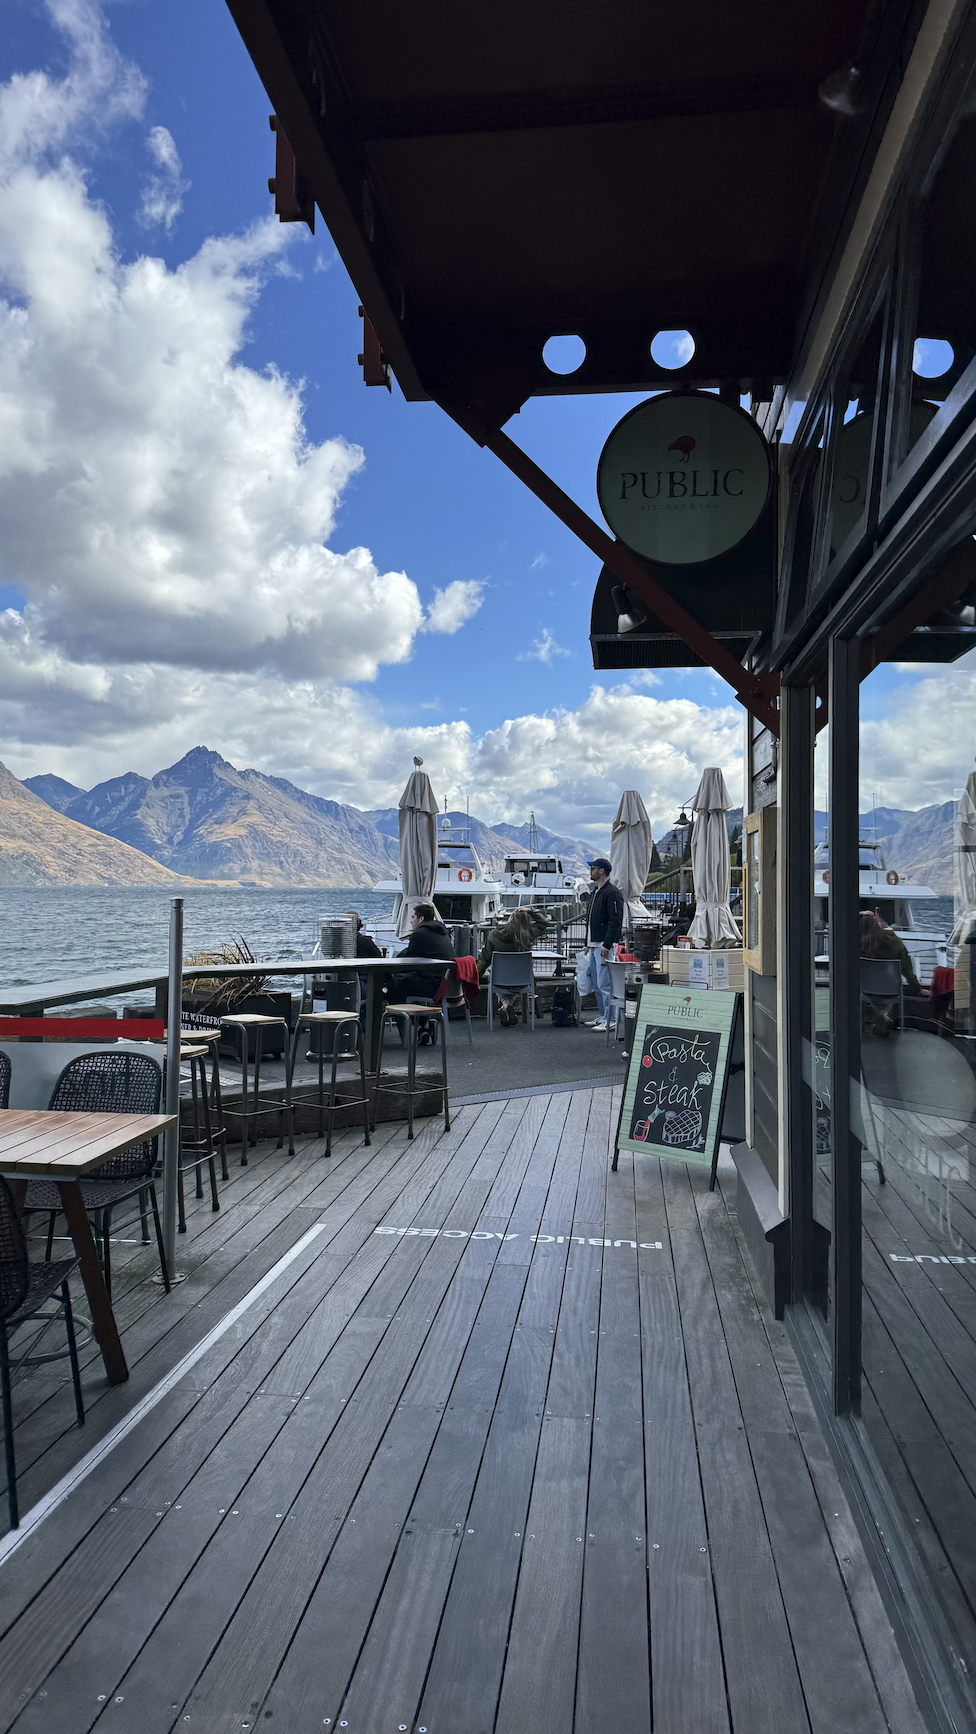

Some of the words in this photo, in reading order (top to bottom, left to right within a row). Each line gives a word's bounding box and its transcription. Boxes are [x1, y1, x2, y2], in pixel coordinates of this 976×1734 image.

[618, 468, 744, 500] PUBLIC
[640, 503, 686, 511] KITCHEN
[689, 502, 696, 510] &
[190, 1012, 222, 1026] WATERFRO
[667, 1005, 704, 1019] PUBLIC
[650, 1034, 711, 1065] Pasta
[643, 1080, 704, 1110] Steak
[374, 1226, 520, 1241] ACCESS
[530, 1235, 663, 1250] PUBLIC
